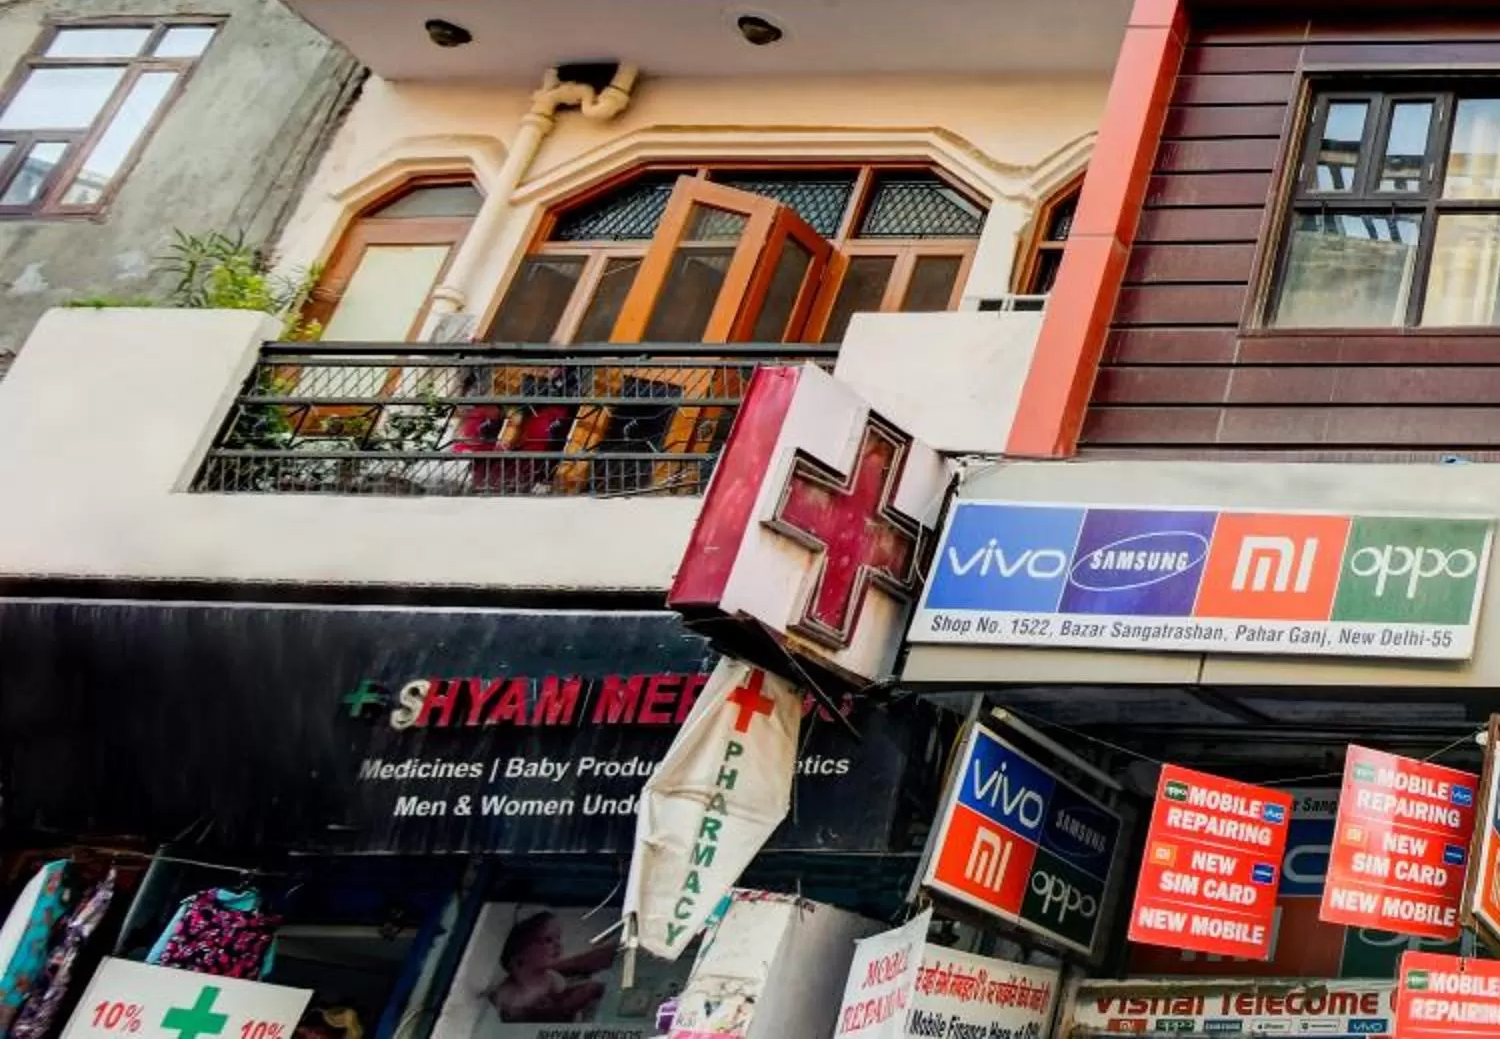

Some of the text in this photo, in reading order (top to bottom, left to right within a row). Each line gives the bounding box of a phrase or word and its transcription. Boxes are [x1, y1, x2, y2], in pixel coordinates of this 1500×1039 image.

[949, 538, 1066, 577] vivo
[1090, 549, 1189, 571] SAMSUNG
[1351, 544, 1477, 599] oppo
[931, 614, 970, 635] Shop
[976, 617, 1001, 634] No.
[1010, 619, 1054, 638] 1522,
[1059, 620, 1105, 638] Bazar
[1235, 625, 1285, 643] Pahar
[1288, 627, 1331, 647] Ganj,
[1338, 628, 1376, 646] New
[1379, 629, 1453, 648] Delhi-55
[390, 675, 583, 730] SHYAM
[359, 757, 484, 781] Medicines
[505, 756, 570, 782] Baby
[1377, 767, 1449, 799] MOBILE
[393, 795, 447, 817] Men
[453, 795, 472, 817] &
[480, 794, 574, 817] Women
[973, 758, 1044, 829] vivo
[1187, 785, 1262, 818] MOBILE
[1356, 787, 1461, 829] REPAIRING
[665, 739, 744, 947] PHARMACY
[1055, 808, 1107, 853] SAMSUNG
[1166, 806, 1273, 847] REPAIRING
[1382, 831, 1428, 858] NEW
[1191, 849, 1238, 877] NEW
[1351, 851, 1391, 878] SIM
[1394, 860, 1448, 887] CARD
[1031, 869, 1097, 924] oppo
[1159, 870, 1257, 906] SIM CARD
[1138, 906, 1265, 945] NEW MOBILE
[1329, 887, 1457, 928] NEW MOBILE
[1429, 972, 1500, 996] MOBILE
[90, 999, 144, 1034] 10%
